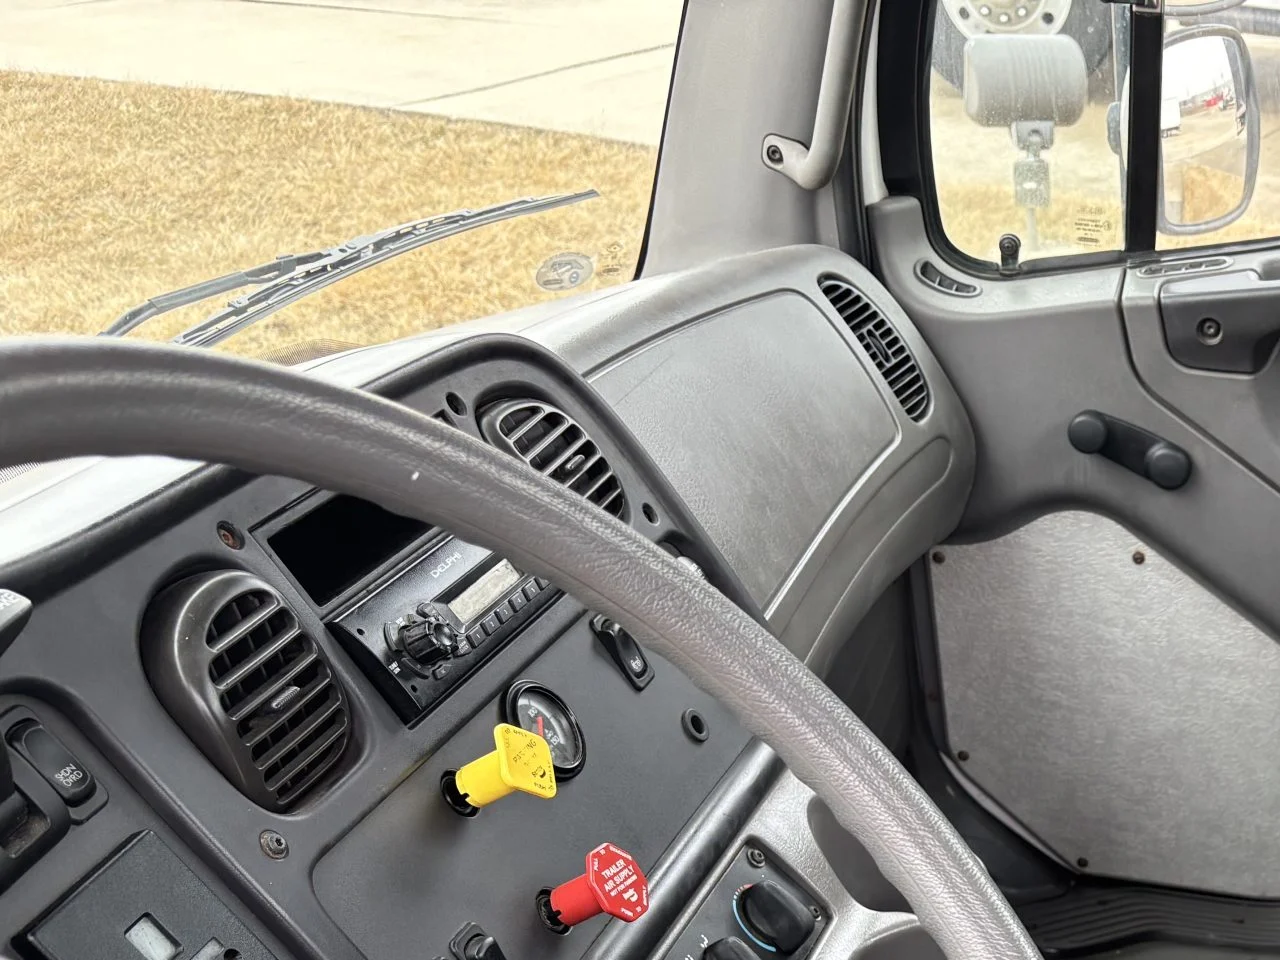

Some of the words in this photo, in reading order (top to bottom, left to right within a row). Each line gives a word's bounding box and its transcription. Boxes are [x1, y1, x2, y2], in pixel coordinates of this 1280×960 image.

[430, 552, 463, 579] DELPHI
[54, 763, 77, 781] SHDN
[63, 770, 83, 787] OVRD
[601, 859, 627, 879] TRAILER
[604, 879, 616, 893] AIR
[613, 864, 635, 885] SUPPLY
